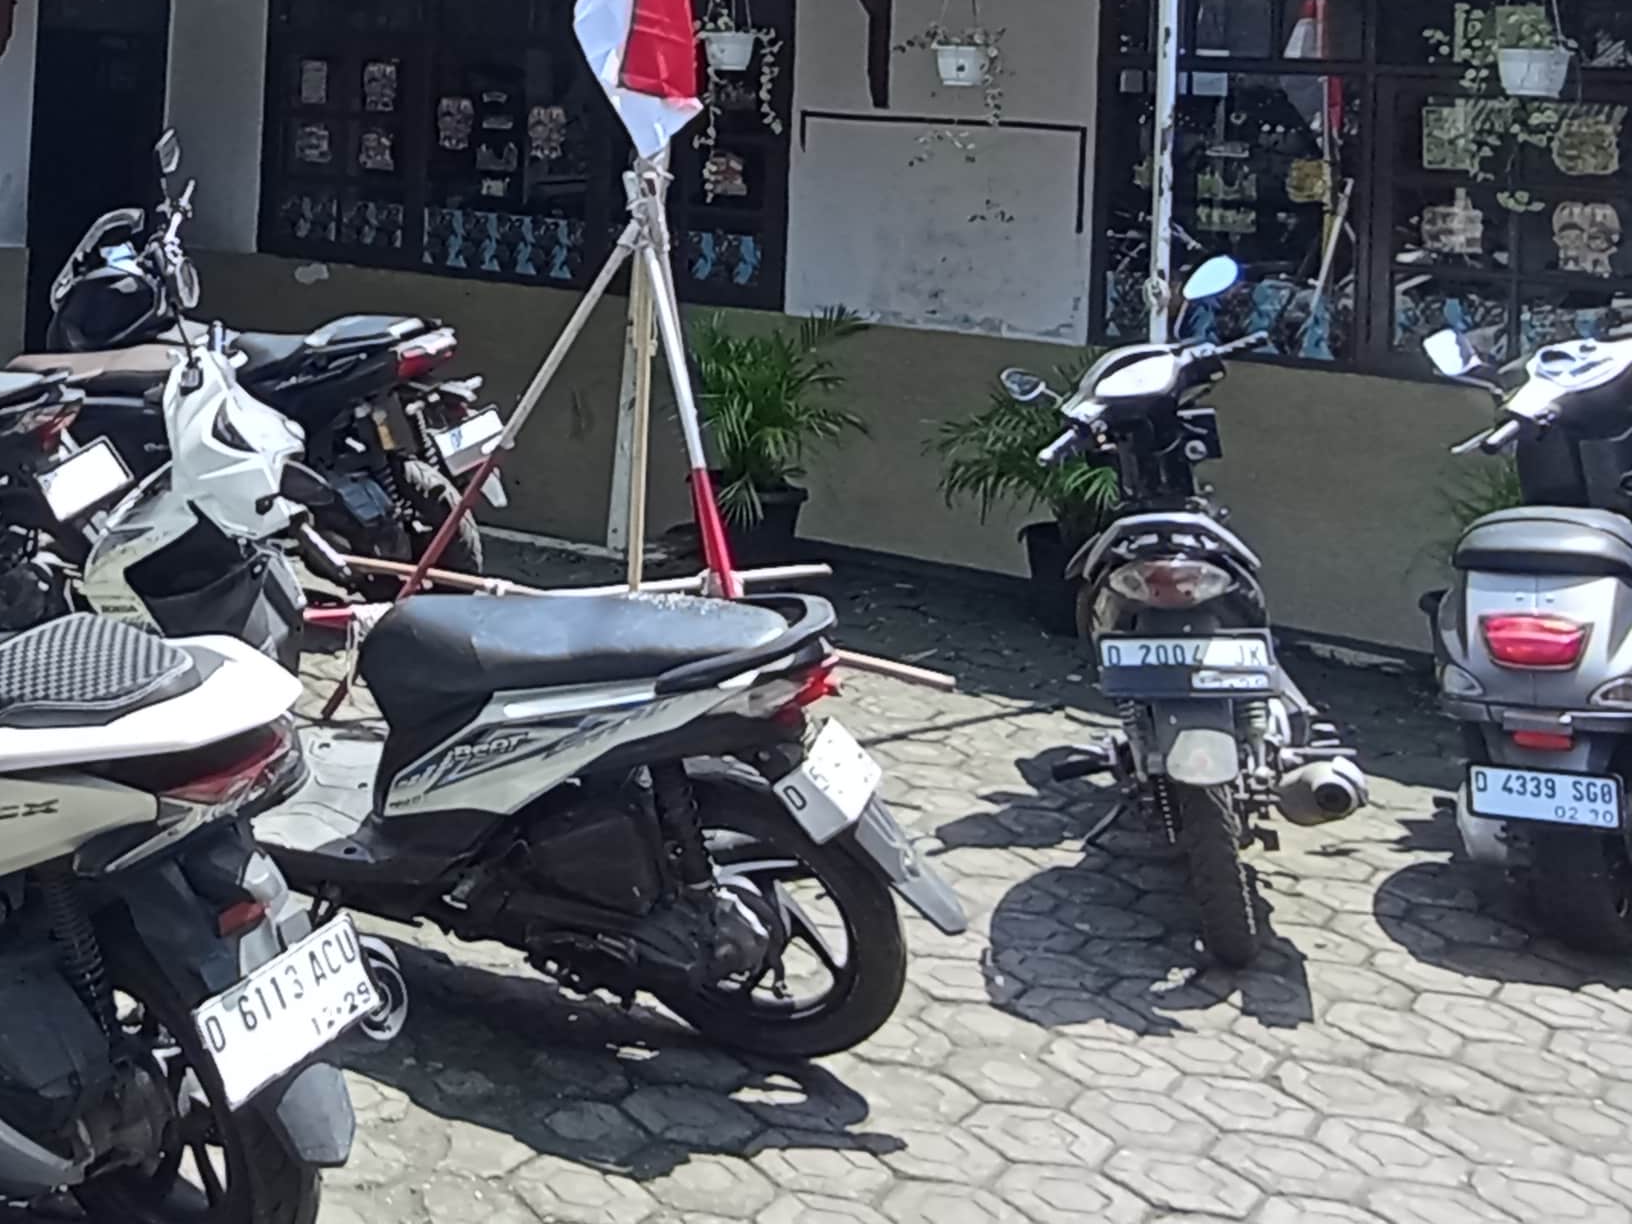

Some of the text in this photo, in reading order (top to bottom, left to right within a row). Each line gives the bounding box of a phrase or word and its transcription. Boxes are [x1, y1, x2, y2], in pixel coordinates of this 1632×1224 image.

[1106, 645, 1121, 667] D
[1474, 771, 1488, 792] D
[1501, 773, 1556, 799] 4339
[1554, 805, 1579, 821] 02
[205, 928, 356, 1053] D 6113 ACU
